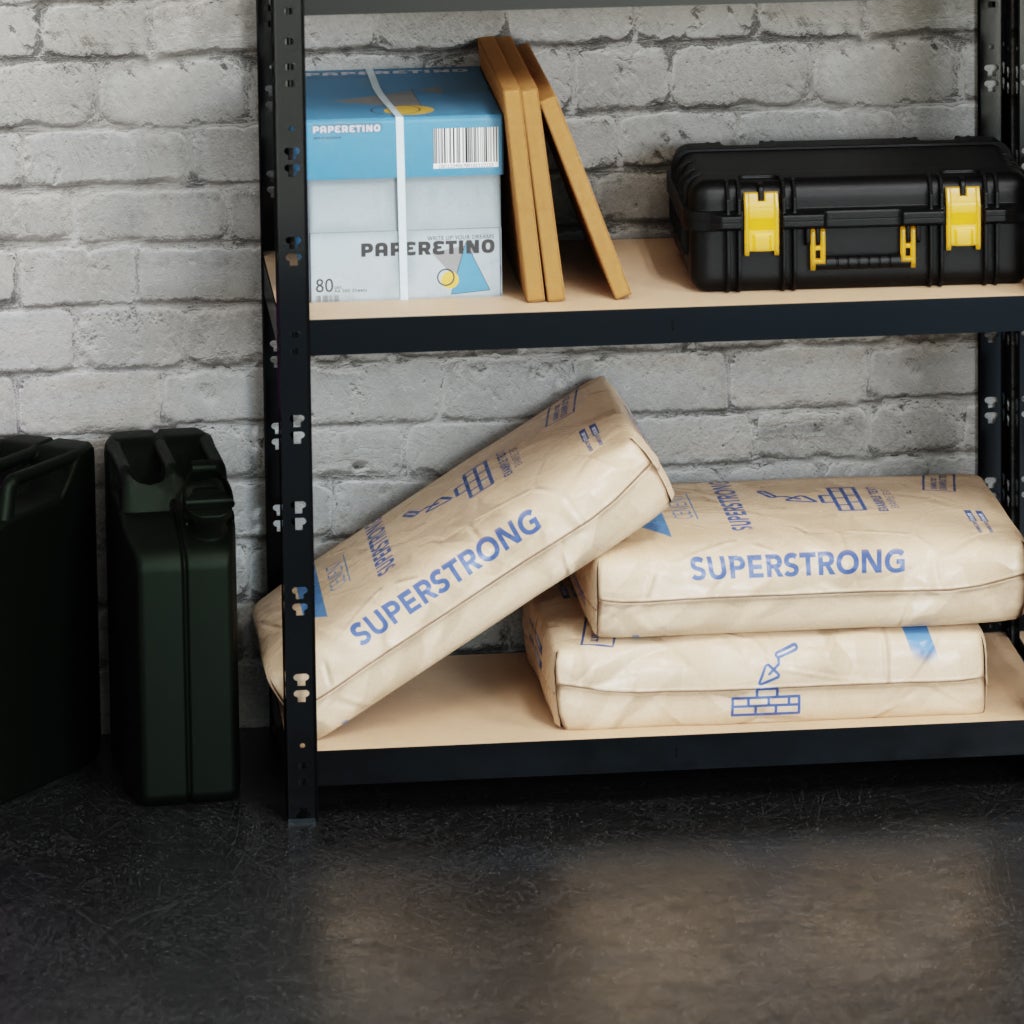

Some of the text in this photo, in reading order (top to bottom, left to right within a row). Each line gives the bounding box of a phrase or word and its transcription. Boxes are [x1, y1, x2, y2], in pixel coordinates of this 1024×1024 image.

[312, 123, 381, 134] PAPERETINO
[361, 239, 495, 257] PAPERETINO
[315, 278, 334, 293] 80
[690, 548, 906, 581] SUPERSTRONG
[350, 509, 542, 646] SUPERSTRONG
